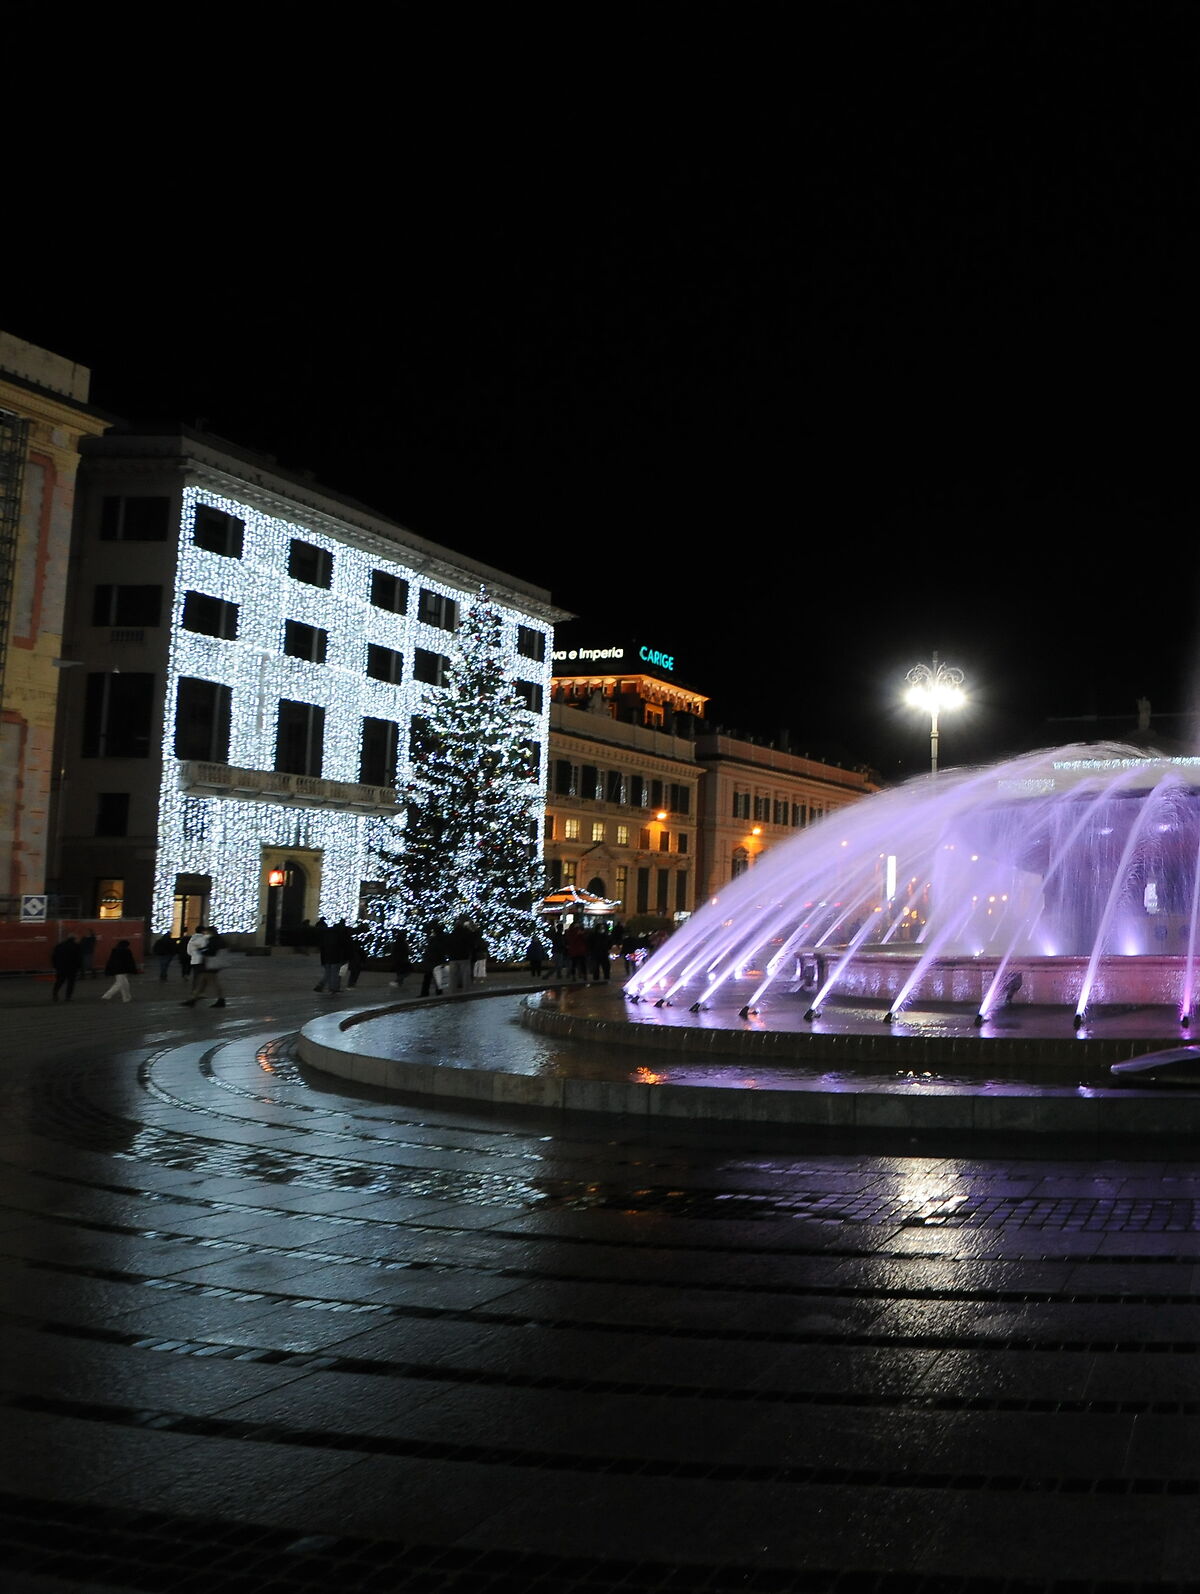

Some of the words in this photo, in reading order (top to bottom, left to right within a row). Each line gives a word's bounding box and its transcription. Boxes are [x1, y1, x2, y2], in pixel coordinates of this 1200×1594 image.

[568, 650, 578, 660] e
[579, 646, 624, 661] Imperia
[639, 646, 674, 671] CARIGE
